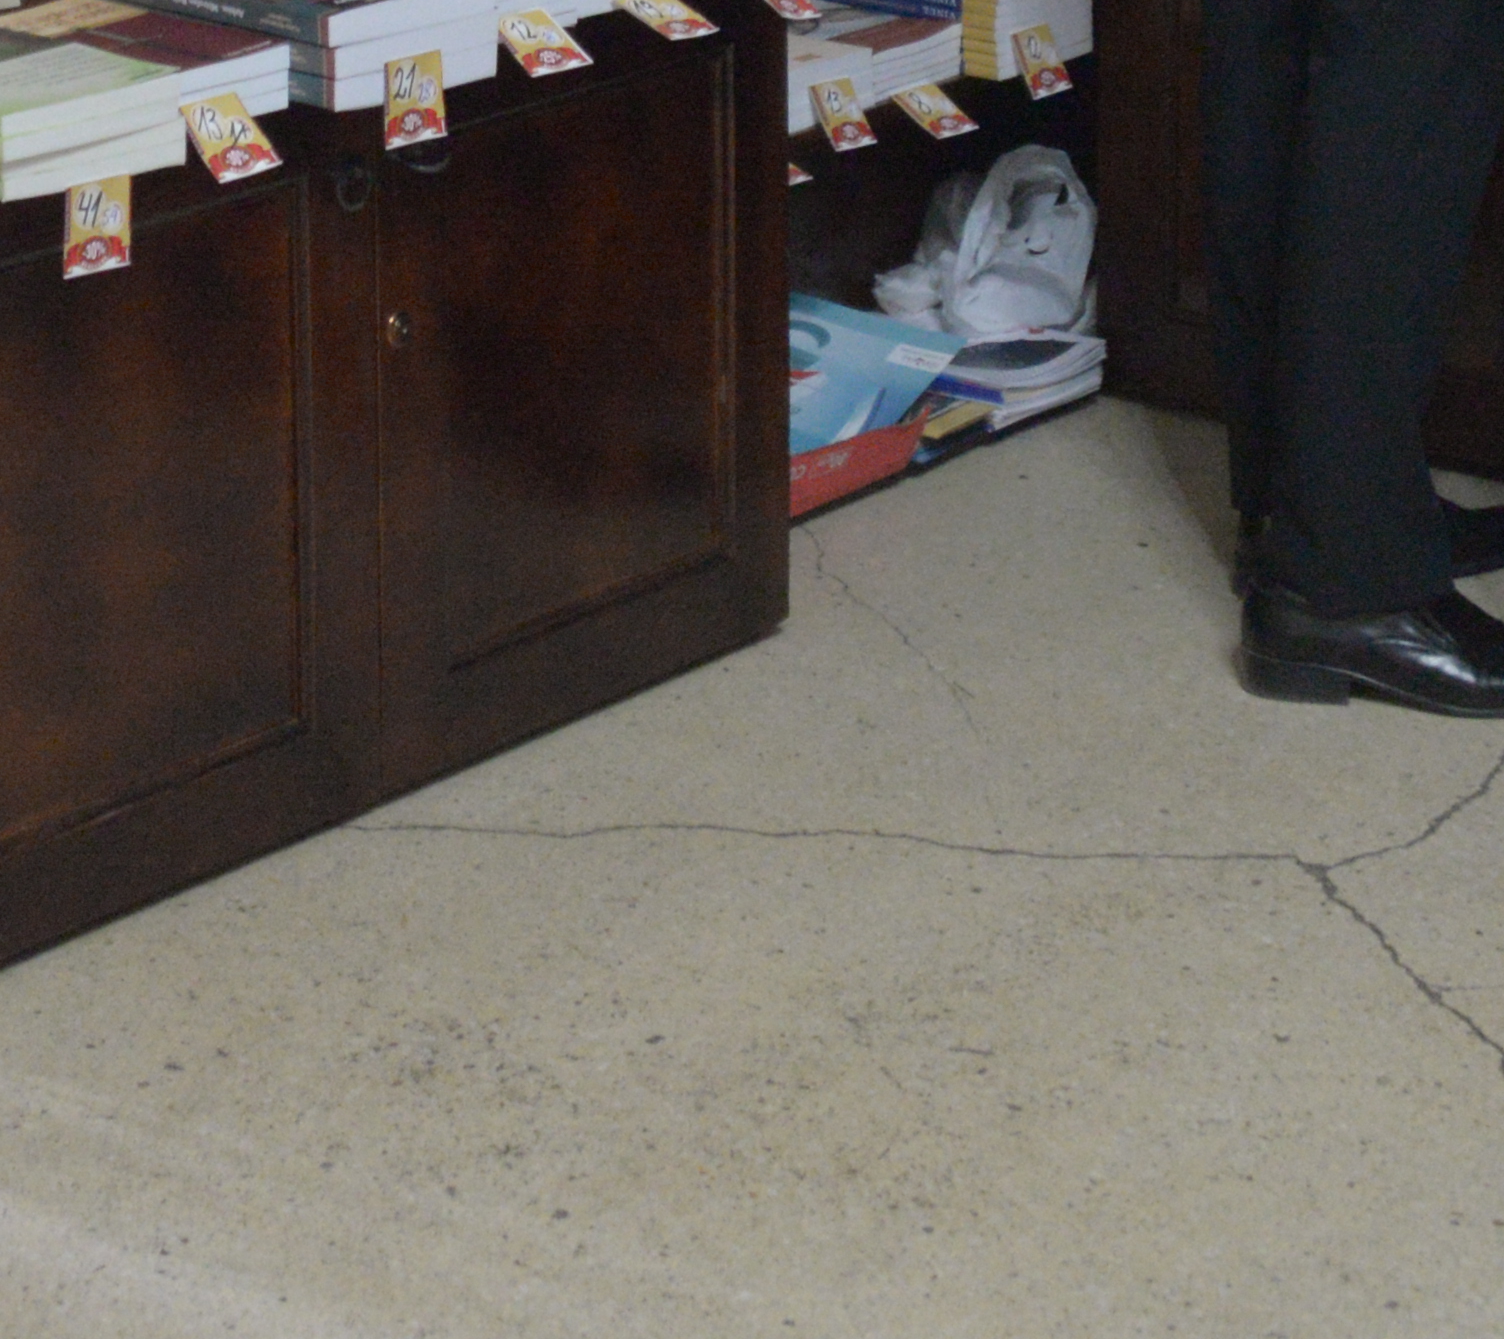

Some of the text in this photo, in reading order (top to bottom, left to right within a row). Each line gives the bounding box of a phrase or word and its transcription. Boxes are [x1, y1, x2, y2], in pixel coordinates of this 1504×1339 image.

[394, 62, 417, 102] 21
[197, 104, 223, 141] 13
[77, 189, 104, 229] 41
